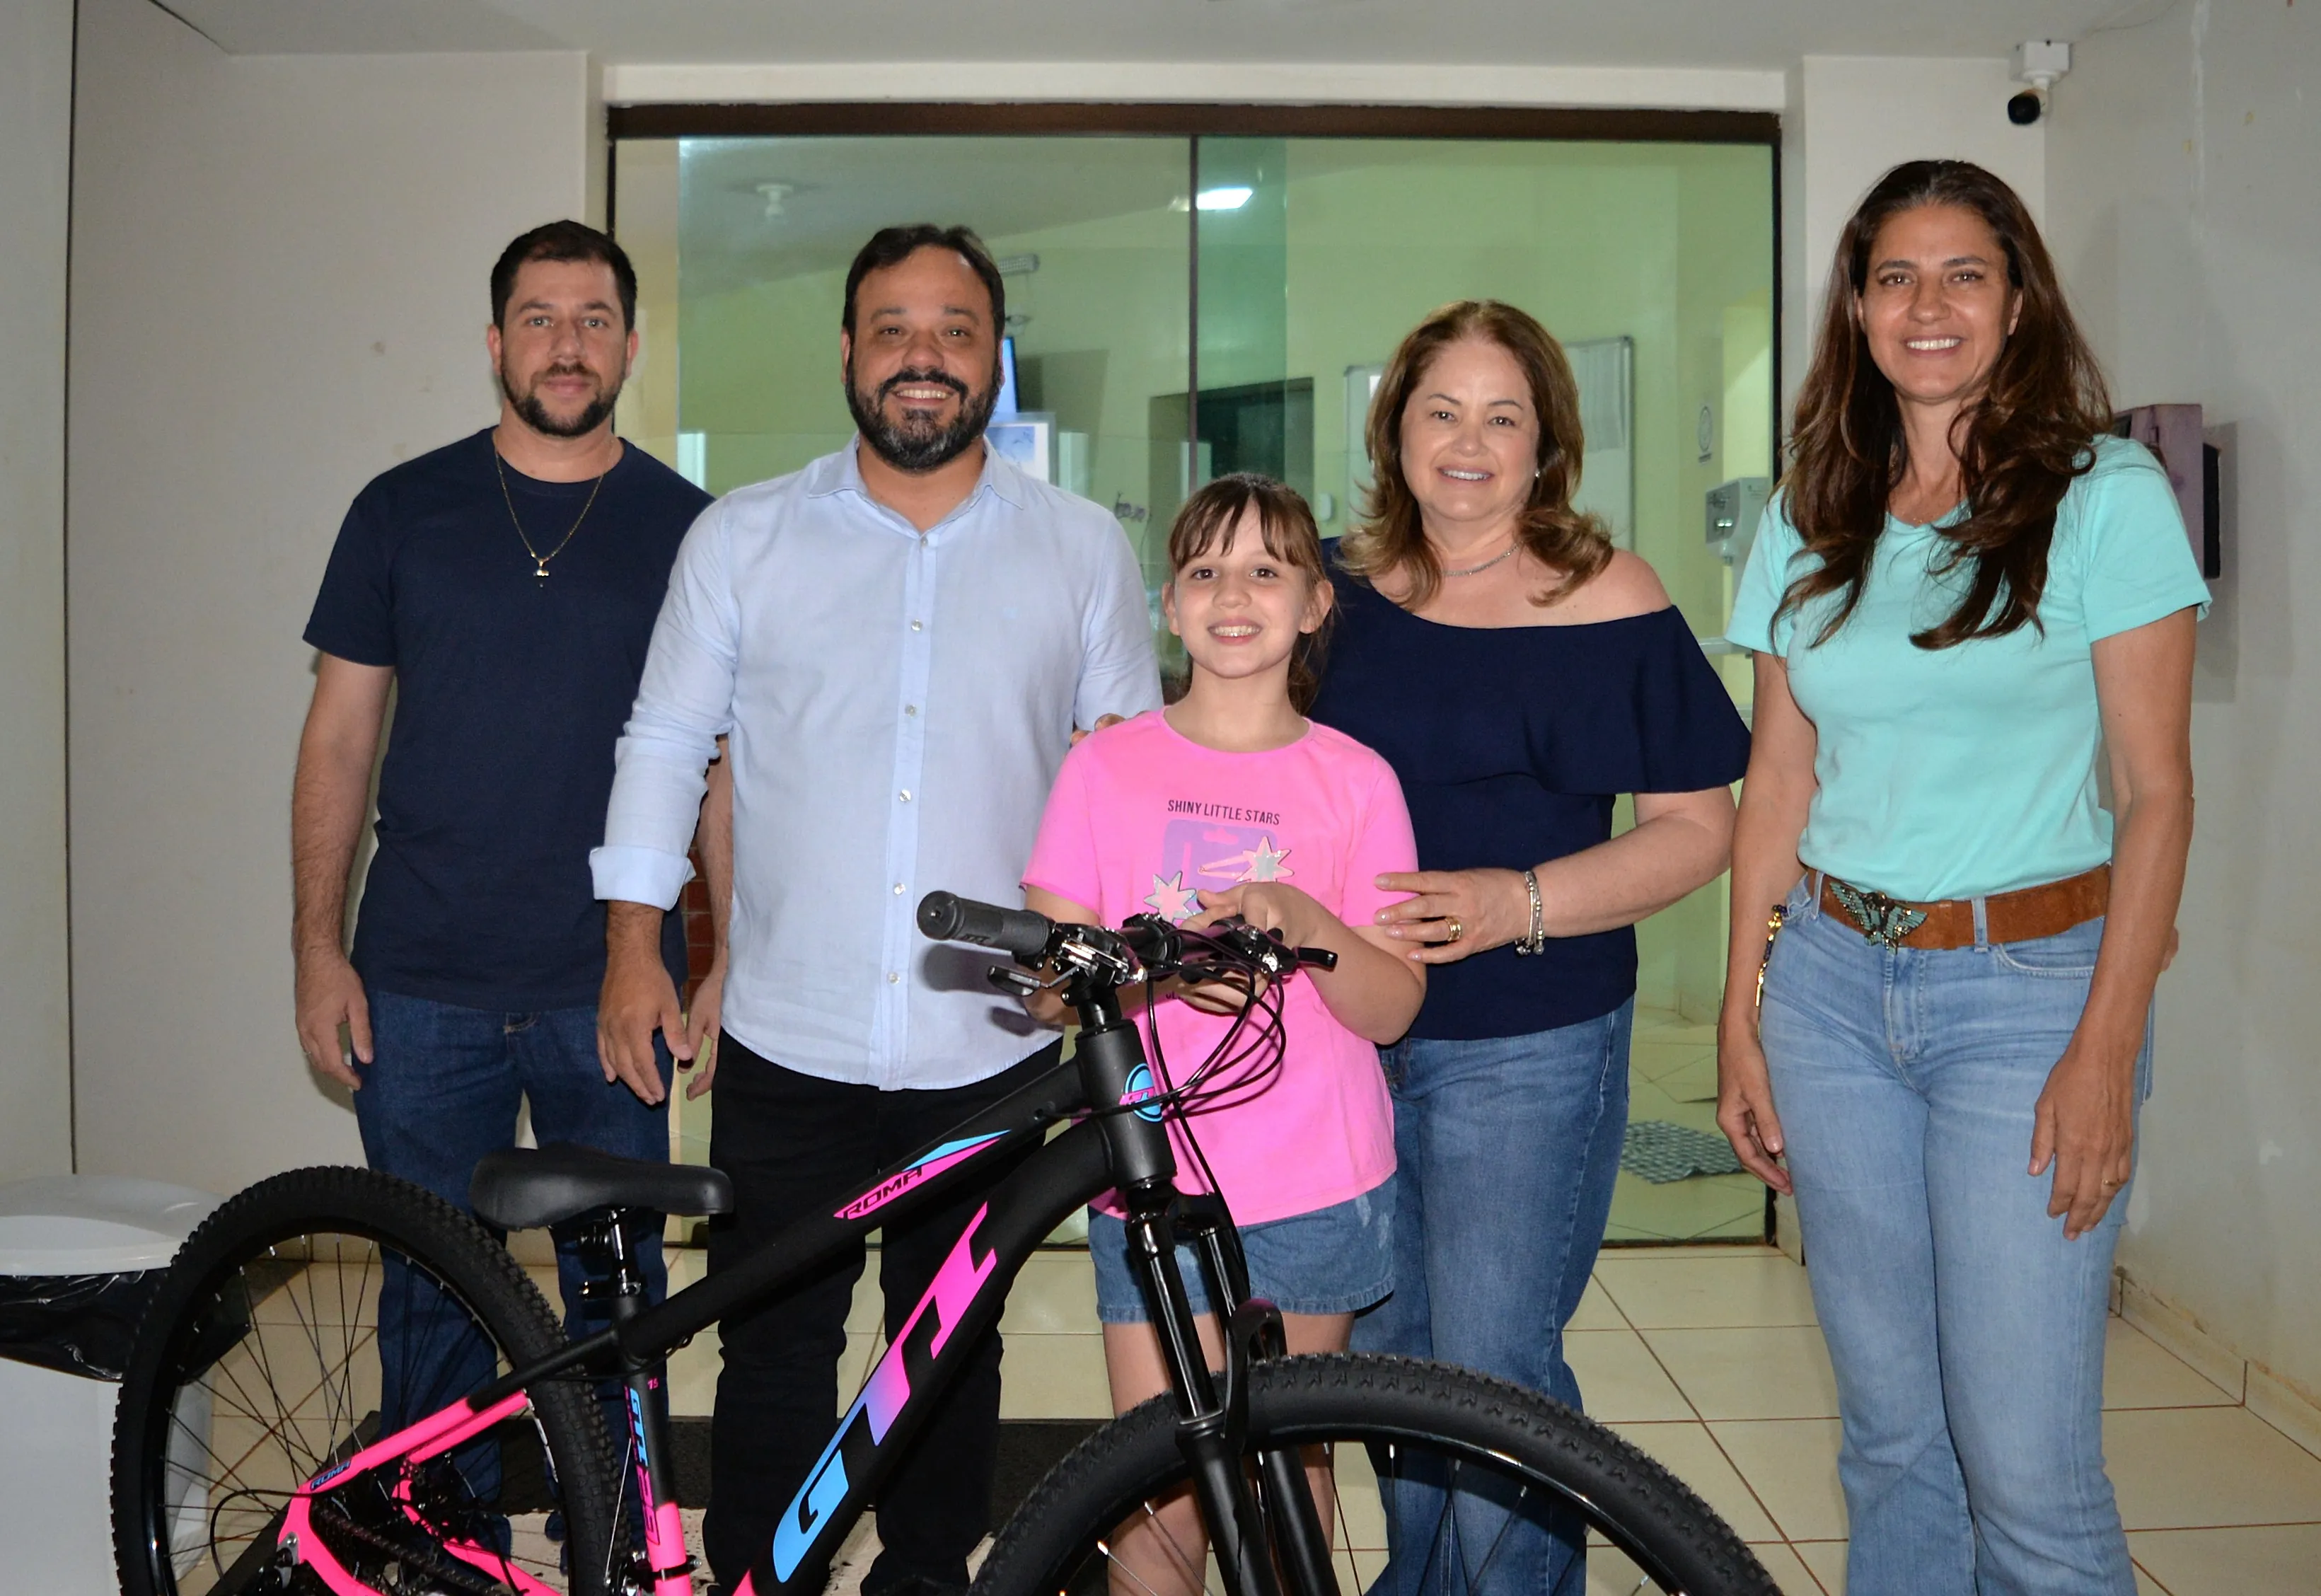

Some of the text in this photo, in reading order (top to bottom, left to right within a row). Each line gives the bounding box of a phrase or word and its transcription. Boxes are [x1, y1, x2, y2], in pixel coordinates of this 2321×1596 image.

[1167, 799, 1280, 826] SHINY LITTLE STARS
[843, 1166, 923, 1219] ROMA
